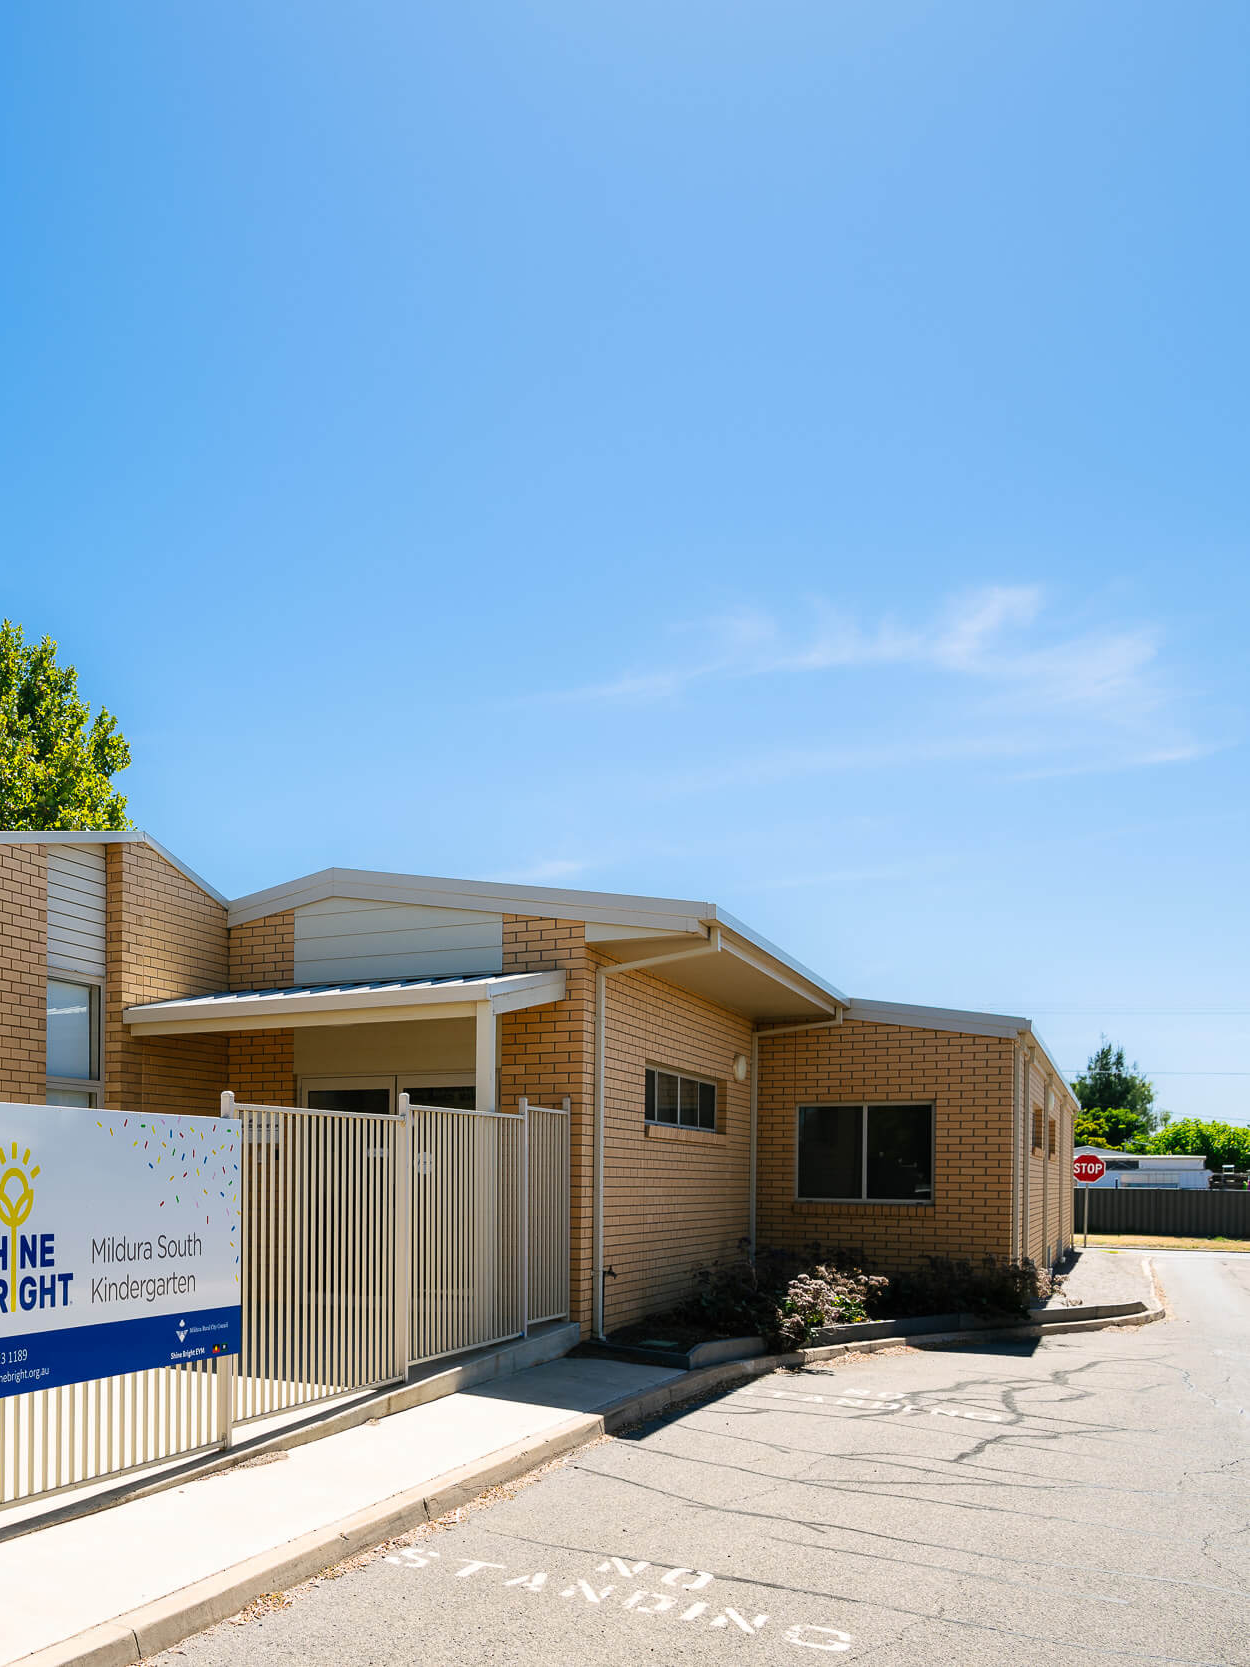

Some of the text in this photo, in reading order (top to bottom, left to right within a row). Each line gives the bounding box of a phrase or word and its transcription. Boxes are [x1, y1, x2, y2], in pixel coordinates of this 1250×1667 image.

[1073, 1163, 1103, 1174] STOP
[91, 1232, 202, 1264] Mildura South
[91, 1272, 196, 1304] Kindergarten
[9, 1349, 28, 1364] 1189
[170, 1347, 205, 1360] Shine Bright EYM
[596, 1556, 715, 1590] NO
[384, 1547, 851, 1653] STANDING
